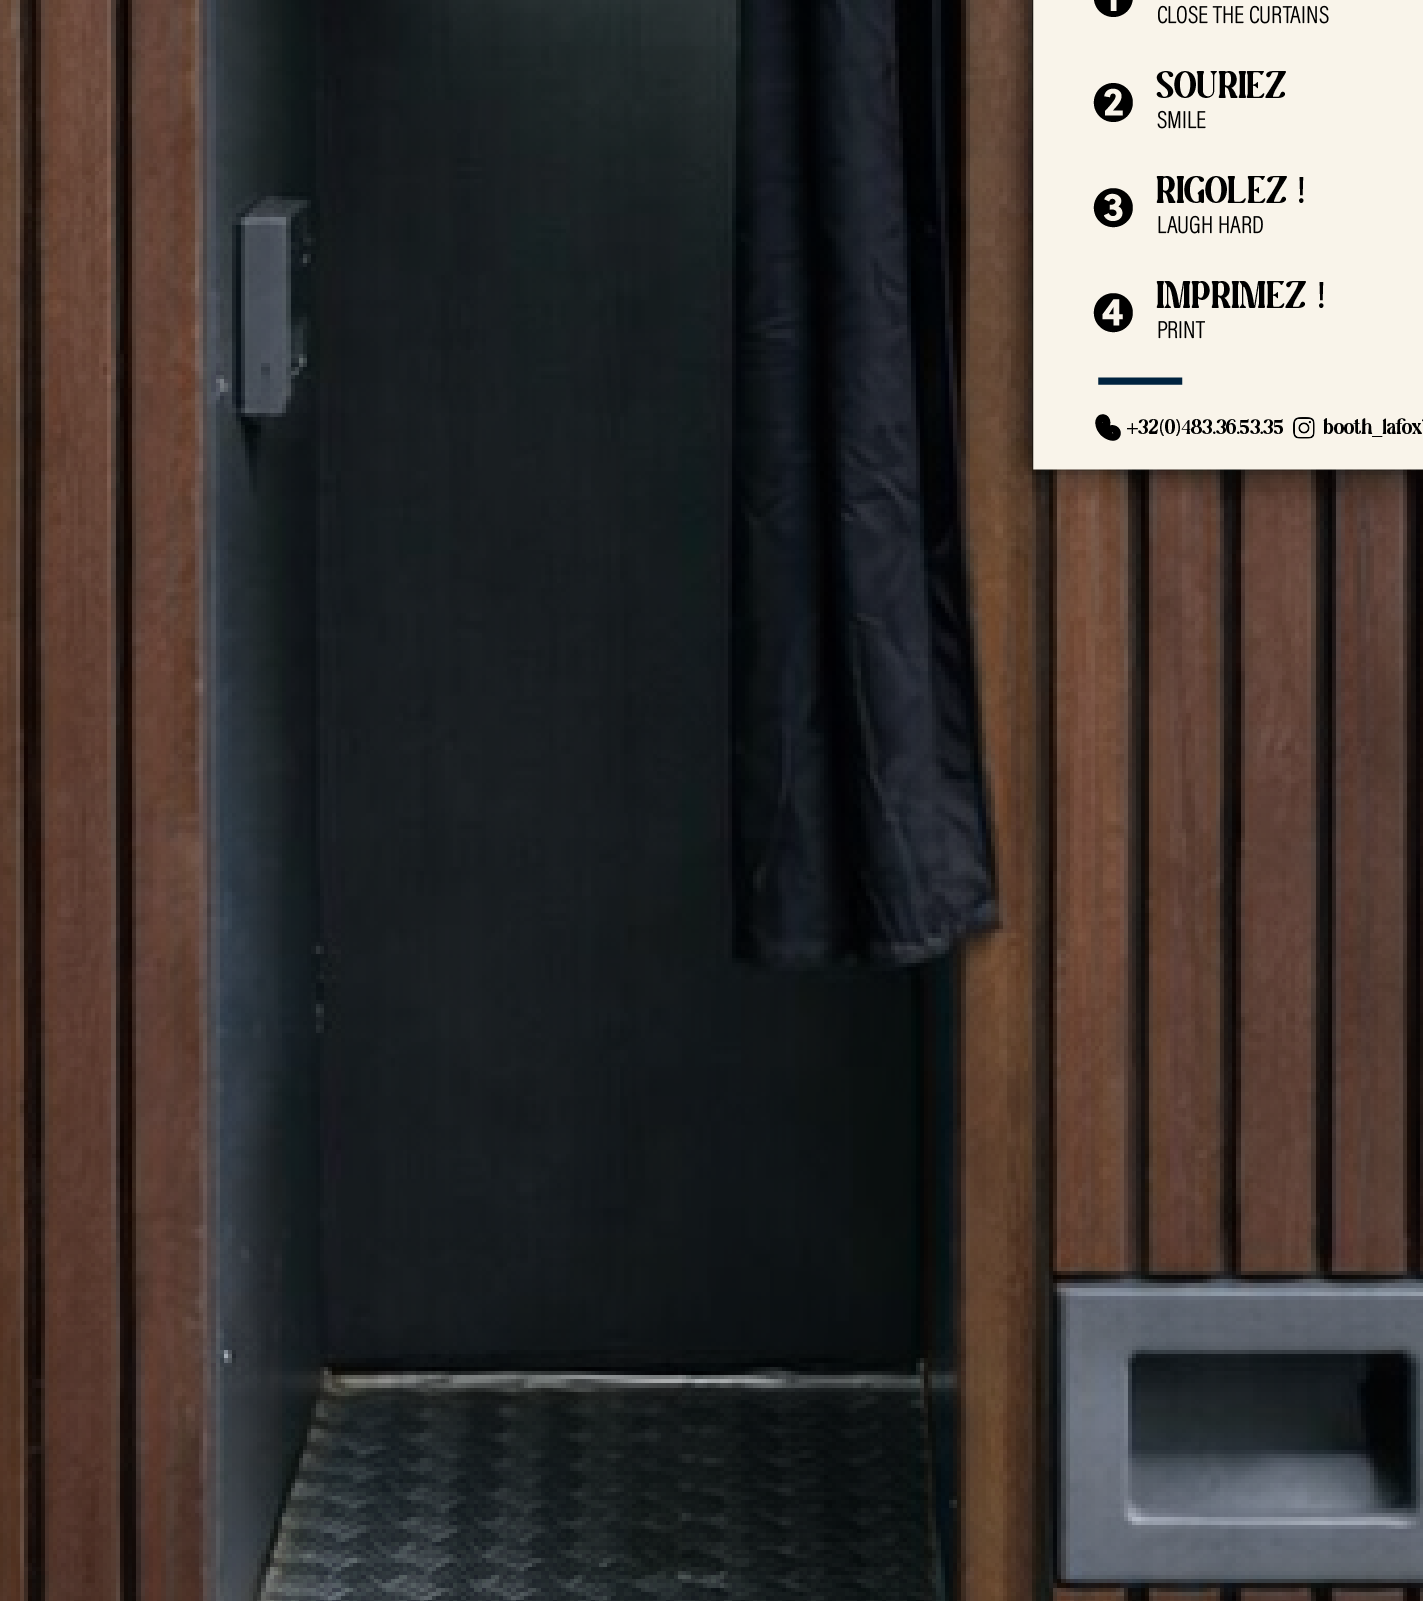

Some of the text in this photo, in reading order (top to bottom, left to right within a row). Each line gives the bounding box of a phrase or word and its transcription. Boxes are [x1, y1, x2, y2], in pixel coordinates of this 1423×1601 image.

[1158, 6, 1329, 24] CLOSE THE CURTAINS
[1157, 71, 1286, 98] SOURIEZ
[1103, 89, 1124, 116] 2
[1158, 111, 1206, 128] SMILE
[1157, 176, 1287, 203] RIGOLEZ
[1103, 193, 1124, 222] 3
[1158, 216, 1263, 234] LAUGH HARD
[1157, 281, 1306, 308] IMPRIMEZ
[1102, 299, 1123, 327] 4
[1158, 321, 1205, 338] PRINT
[1127, 419, 1283, 436] +32(0)483.36.53.35
